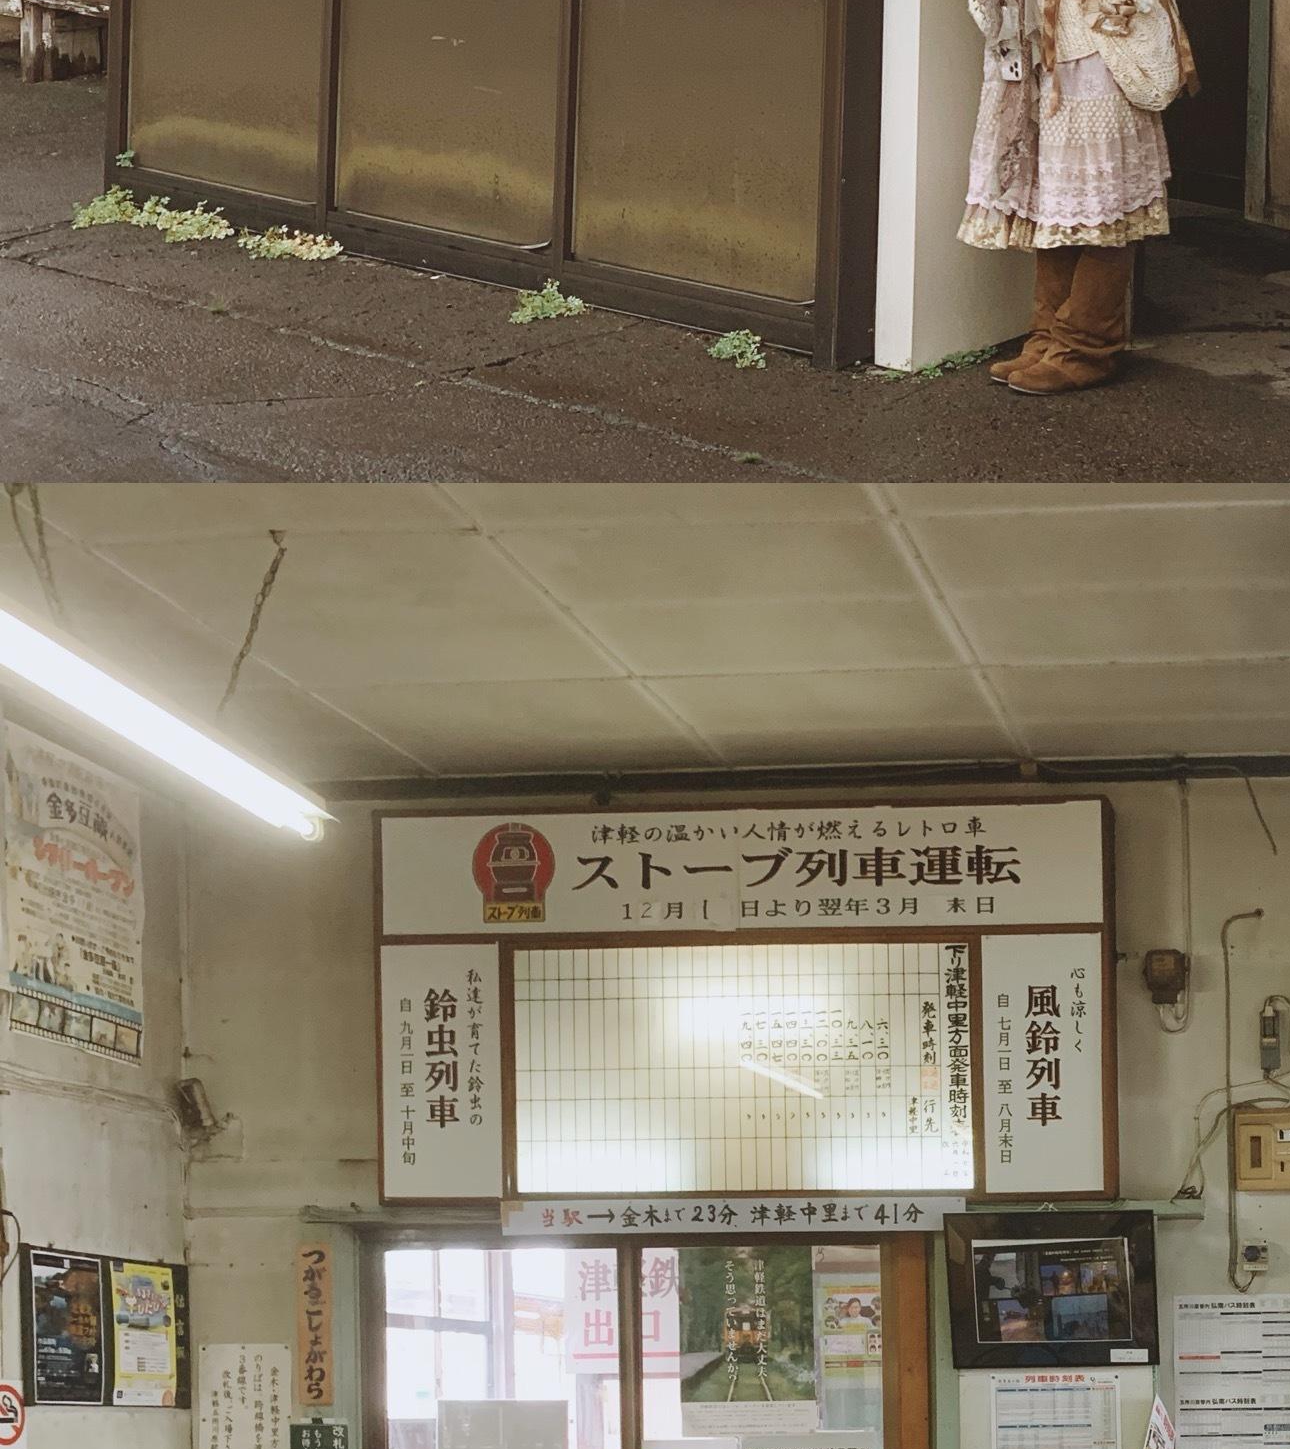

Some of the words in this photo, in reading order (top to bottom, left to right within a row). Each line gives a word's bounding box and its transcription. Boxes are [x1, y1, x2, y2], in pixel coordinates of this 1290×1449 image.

[590, 816, 988, 845] 津軽の温かい人情が燃えるレトロ車
[570, 844, 1022, 890] ストーブ列車運転
[486, 904, 543, 922] ストーブ列車
[922, 1001, 938, 1064] 発車時刻
[1069, 966, 1087, 1054] 心も涼しく
[423, 987, 459, 1130] 鈴虫列車
[465, 967, 486, 1127] 私達が育てた鈴虫の
[1024, 984, 1064, 1127] 風鈴列車
[924, 1099, 939, 1134] 行先
[541, 1205, 585, 1229] 当駅
[750, 1199, 924, 1229] 津軽中里まで41分
[302, 1249, 326, 1400] つがるごしょがわら
[753, 1259, 767, 1378] 津軽鉄道はまだ大丈夫
[1024, 1375, 1085, 1384] 列車時刻表
[1212, 1397, 1257, 1405] 弘南バス時刻表
